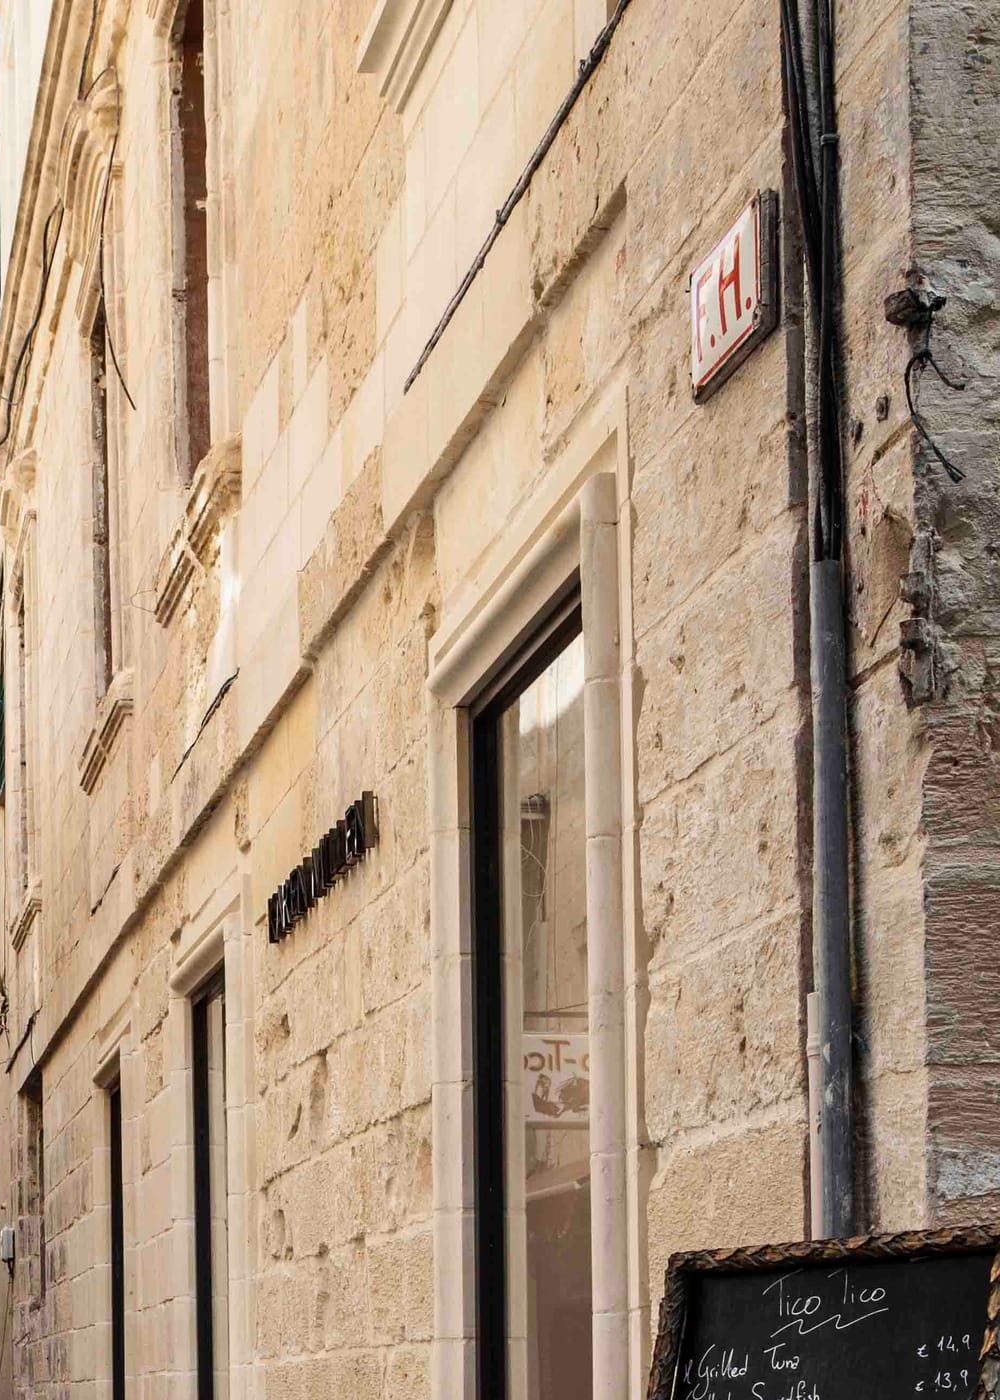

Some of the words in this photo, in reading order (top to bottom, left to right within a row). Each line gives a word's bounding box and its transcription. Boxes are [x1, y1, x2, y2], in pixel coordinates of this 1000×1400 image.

[763, 1269, 821, 1317] Tico
[827, 1270, 886, 1304] Tico
[764, 1343, 800, 1370] Tuna
